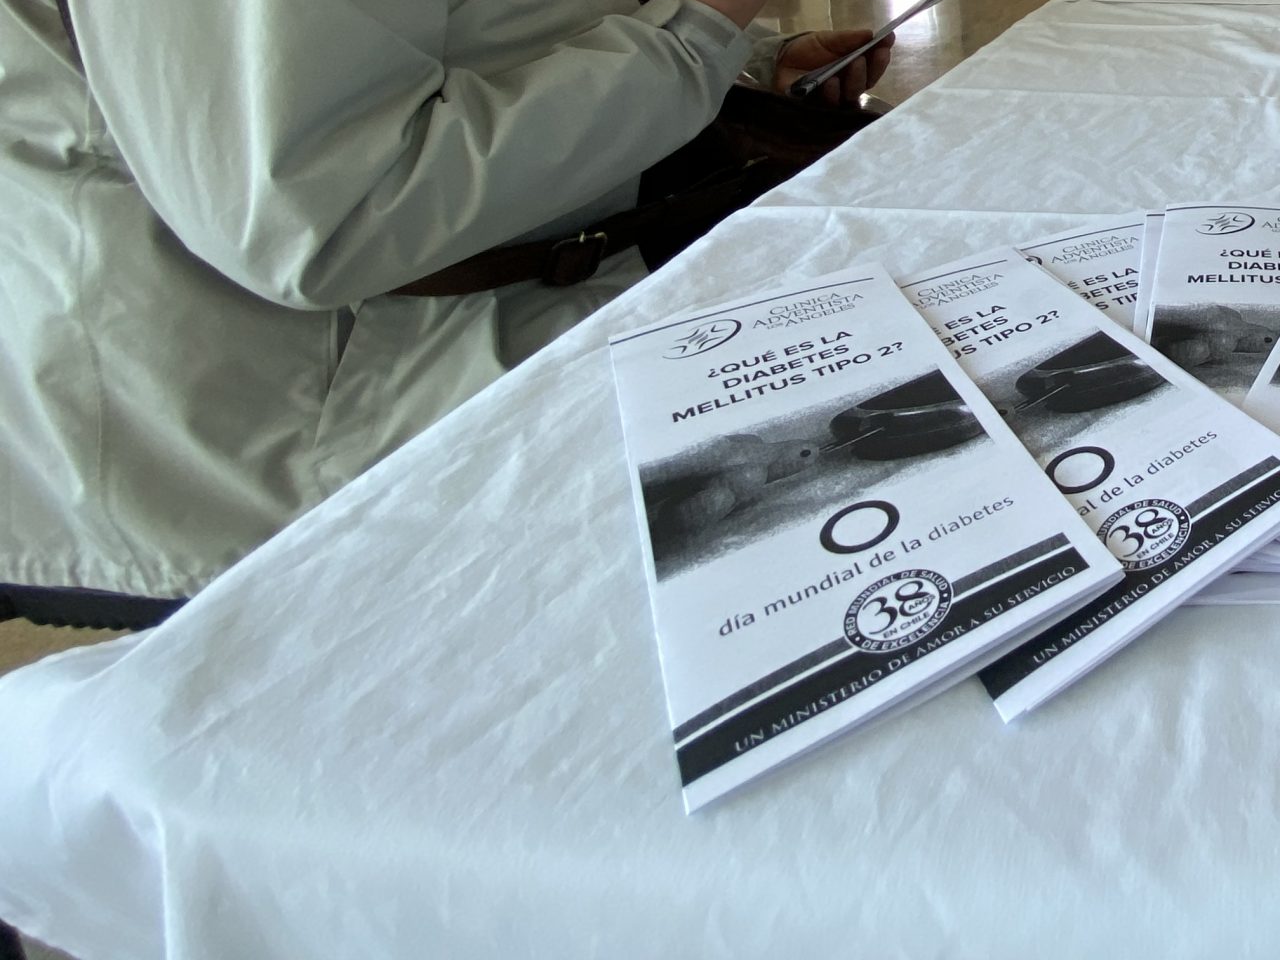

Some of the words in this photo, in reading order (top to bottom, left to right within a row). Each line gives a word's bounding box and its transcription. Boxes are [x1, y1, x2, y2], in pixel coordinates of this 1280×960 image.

[1220, 249, 1272, 259] ¿QUÉ
[753, 294, 864, 328] ADVENTISTA
[769, 293, 840, 315] CLINICA
[785, 303, 855, 327] ANGELES
[944, 316, 973, 329] ES
[976, 305, 1007, 317] LA
[979, 322, 1032, 347] TIPO
[1036, 310, 1060, 325] 2?
[708, 350, 777, 378] ¿QUÉ
[784, 341, 814, 356] ES
[821, 331, 853, 344] LA
[723, 344, 849, 389] DIABETES
[672, 374, 806, 423] MELLITUS
[812, 353, 871, 377] TIPO
[878, 342, 903, 356] 2?
[1100, 485, 1124, 504] de
[1124, 471, 1144, 488] la
[1147, 430, 1218, 476] diabetes
[719, 611, 755, 637] día
[764, 562, 863, 616] mundial
[869, 546, 896, 568] de
[900, 534, 922, 553] la
[928, 496, 1014, 542] diabetes
[920, 571, 947, 590] SALUD
[848, 576, 896, 614] MUNDIAL
[862, 581, 932, 635] 38
[1032, 644, 1059, 664] UN
[1061, 582, 1149, 644] MINISTERIO
[1151, 569, 1170, 585] DE
[1173, 540, 1214, 570] AMOR
[1215, 534, 1224, 542] A
[1225, 518, 1242, 532] SU
[846, 617, 857, 636] RED
[862, 640, 880, 650] DE
[882, 601, 948, 649] EXCELENCIA
[883, 628, 897, 638] EN
[900, 611, 930, 630] CHILE
[734, 728, 765, 752] UN
[772, 669, 883, 735] MINISTERIO
[889, 653, 909, 672] DE
[916, 624, 966, 657] AMOR
[969, 618, 980, 629] A
[984, 603, 1004, 620] SU
[1008, 565, 1076, 606] SERVICIO
